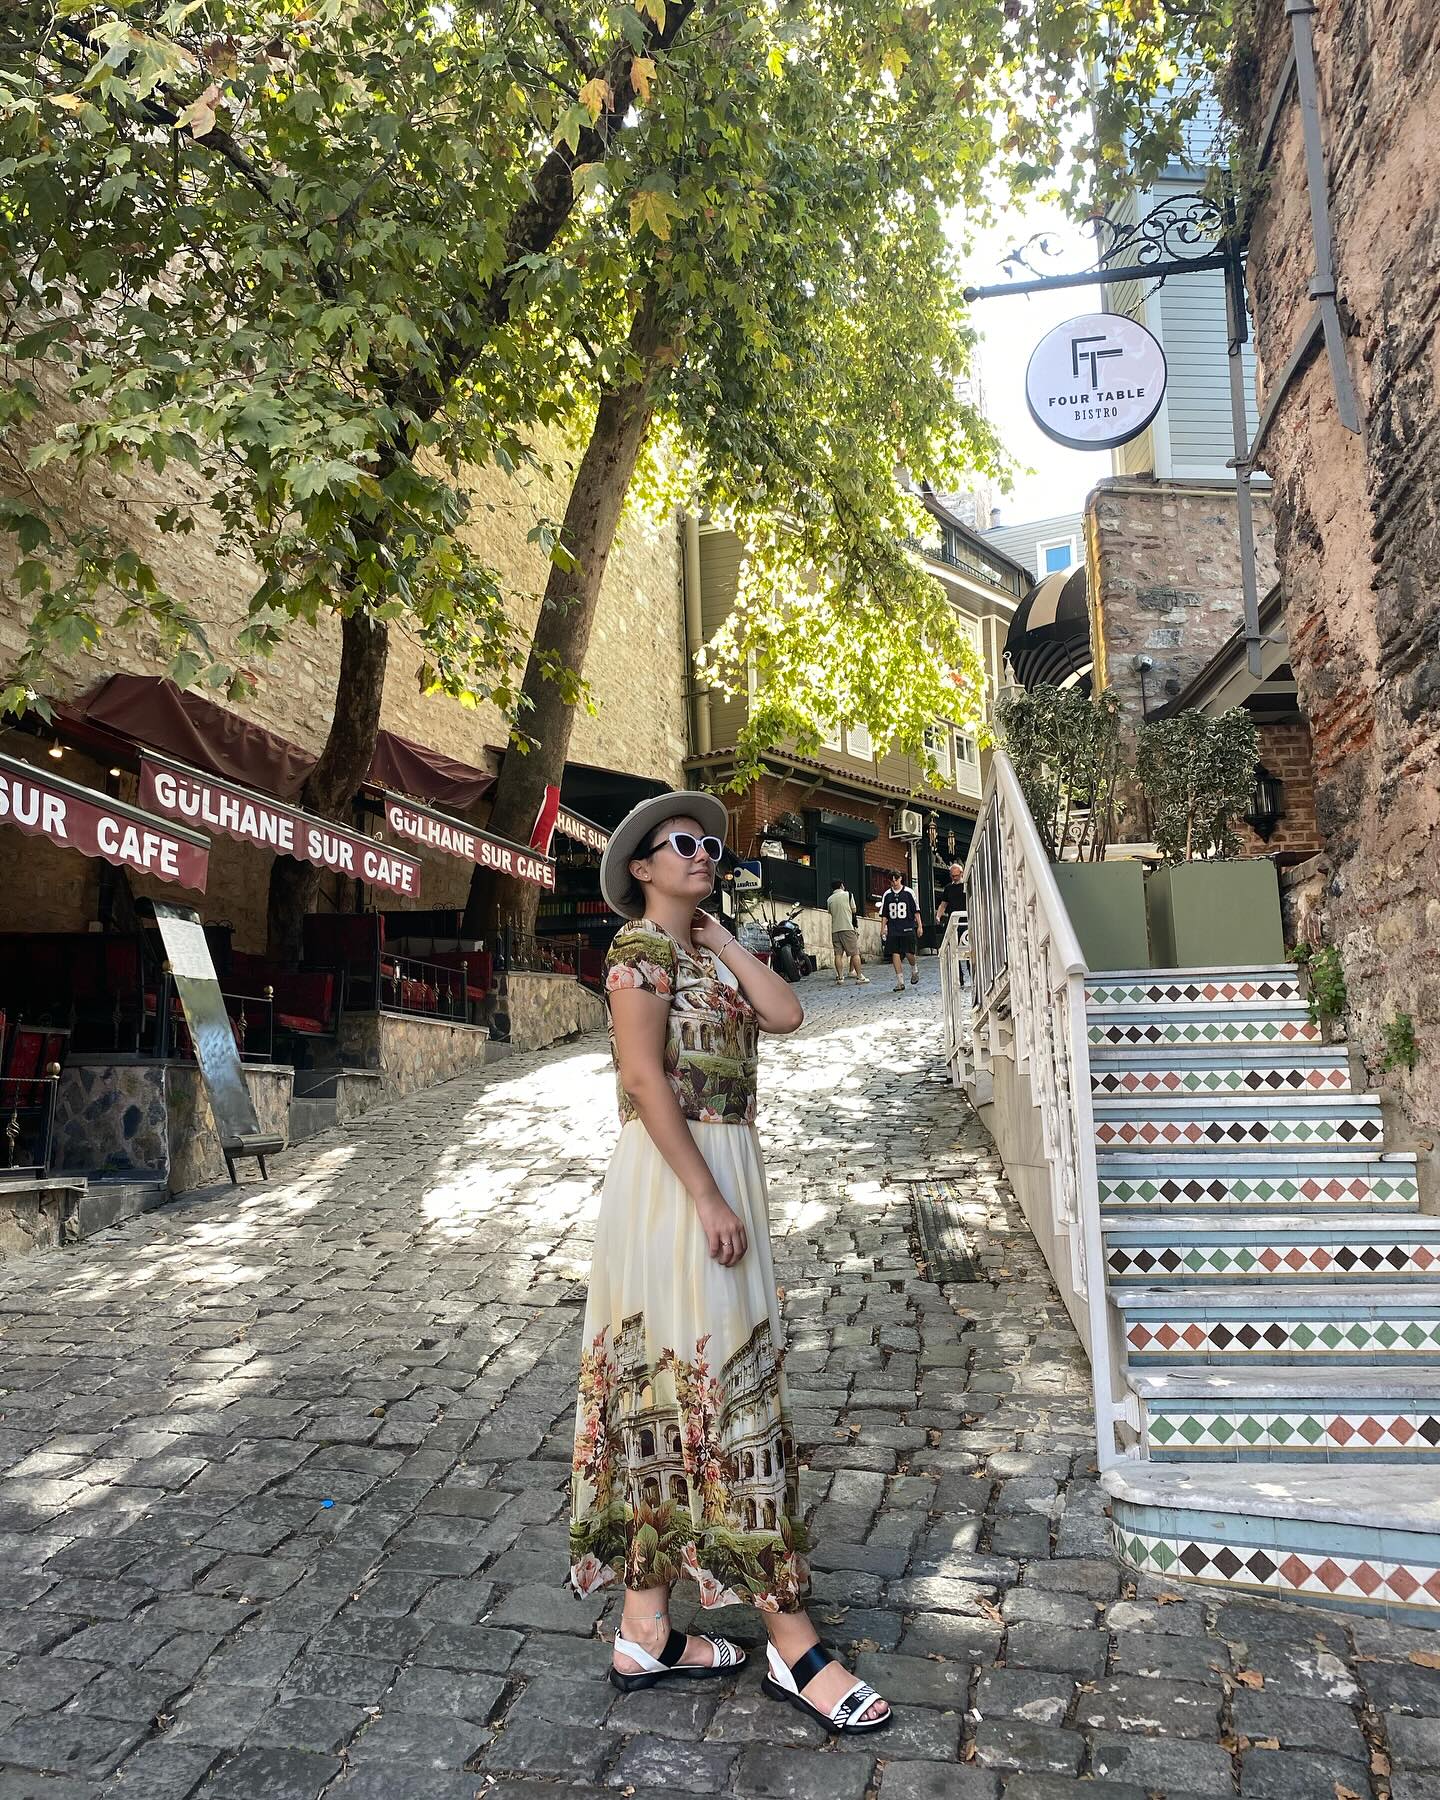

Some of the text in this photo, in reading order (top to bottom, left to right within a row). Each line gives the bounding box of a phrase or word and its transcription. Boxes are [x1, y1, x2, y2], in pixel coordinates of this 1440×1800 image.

[1049, 388, 1145, 407] FOUR TABLE
[1074, 406, 1118, 421] BISTRO
[154, 773, 413, 892] GÜLHANE SUR CAFE
[587, 829, 609, 853] SUR
[97, 816, 180, 877] CAFE
[389, 806, 554, 885] GÜLHANE SUR CAFE
[889, 901, 907, 919] 88
